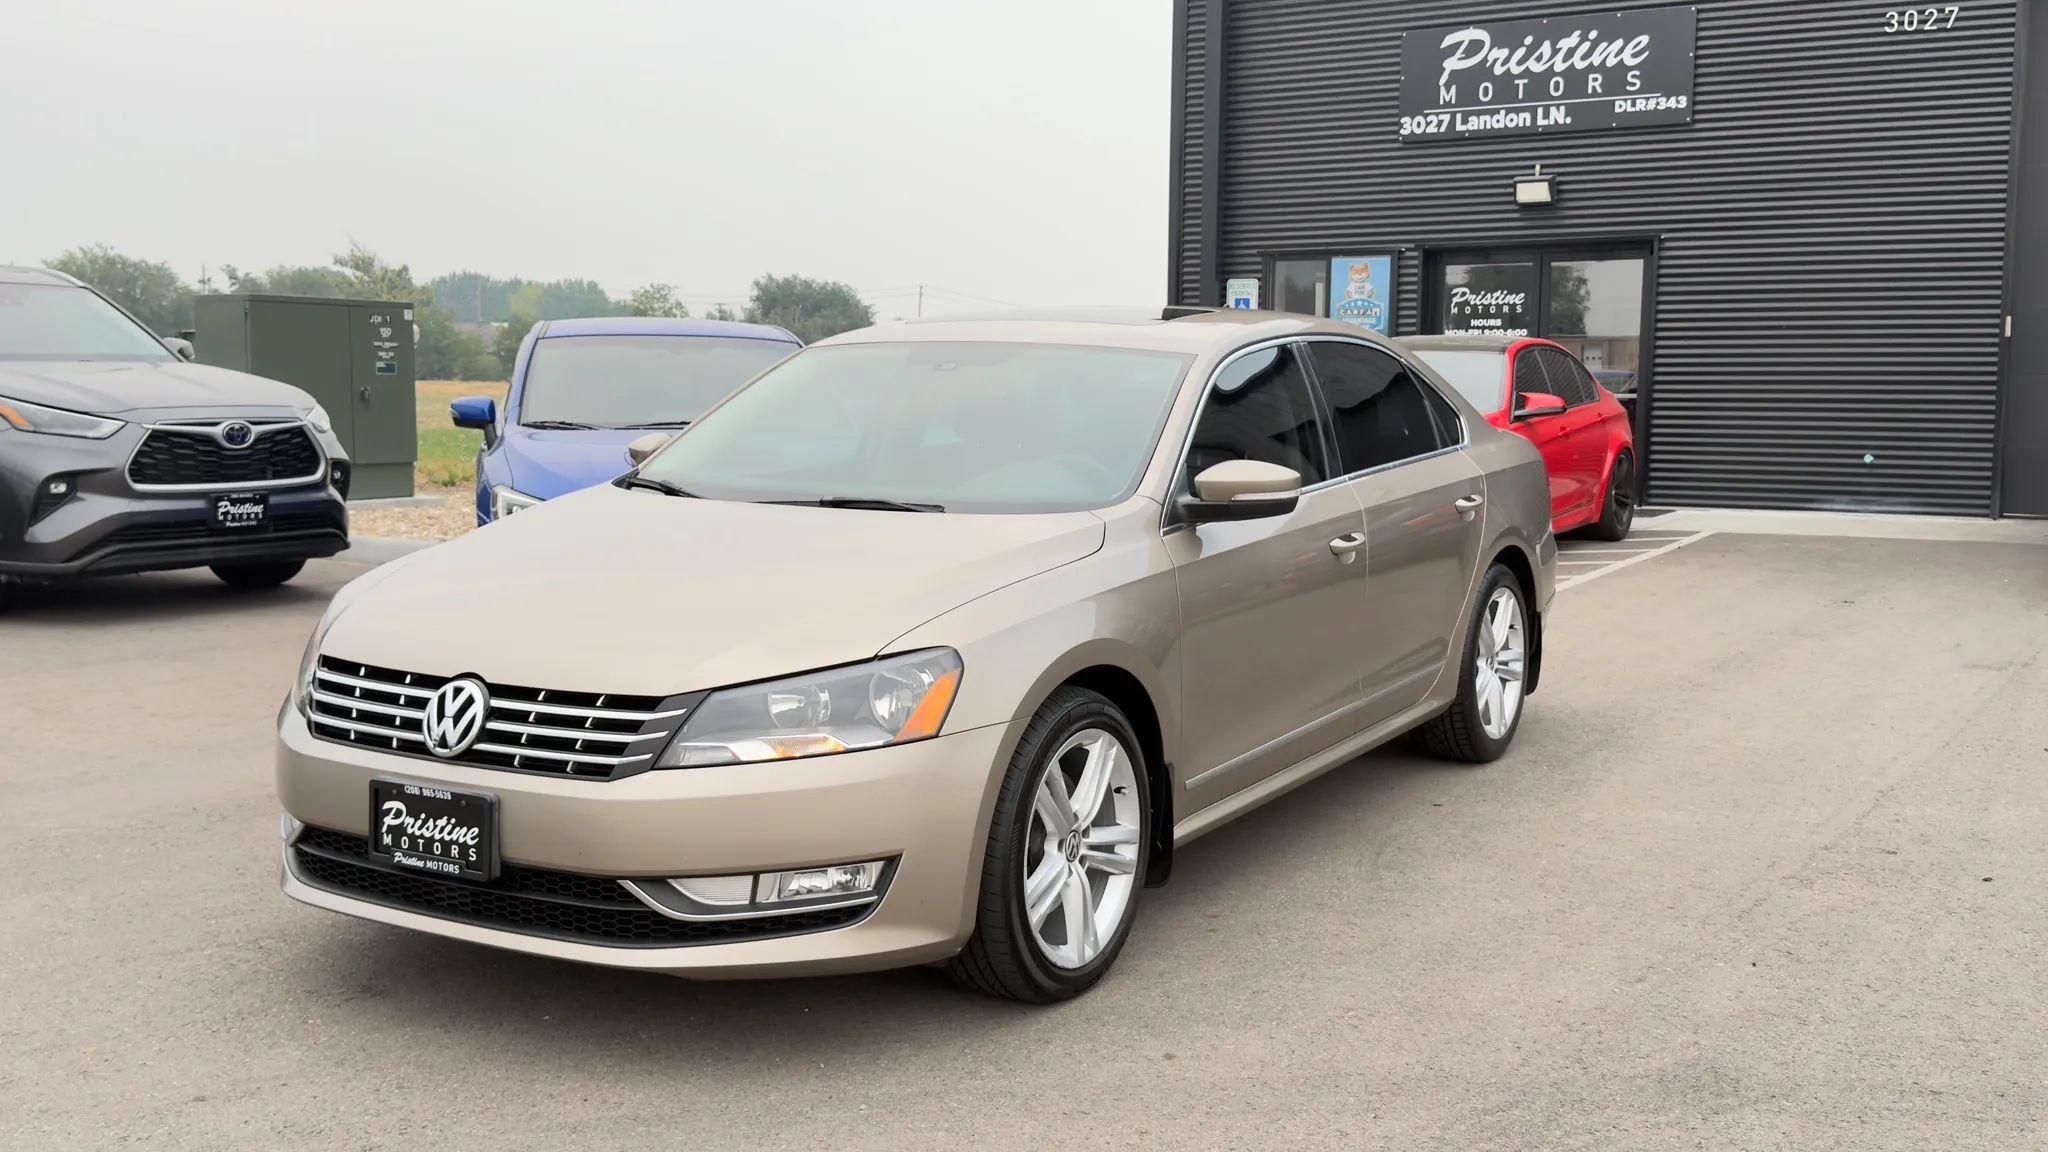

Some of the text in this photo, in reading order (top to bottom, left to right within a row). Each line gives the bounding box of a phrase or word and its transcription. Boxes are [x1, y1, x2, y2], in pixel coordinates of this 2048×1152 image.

[1884, 6, 1959, 33] 3027
[1440, 28, 1650, 86] Pristine
[1440, 70, 1642, 105] MOTORS
[1614, 95, 1688, 113] DLR#343
[1400, 106, 1572, 135] 3027 Landon LN.
[1451, 287, 1525, 308] Pristine
[1451, 305, 1522, 314] MOTORS
[1470, 319, 1502, 327] HOURS
[217, 501, 264, 516] Pristine
[381, 800, 480, 846] Pristine
[383, 833, 477, 862] MOTORS
[393, 852, 460, 874] Pristine MOTORS
